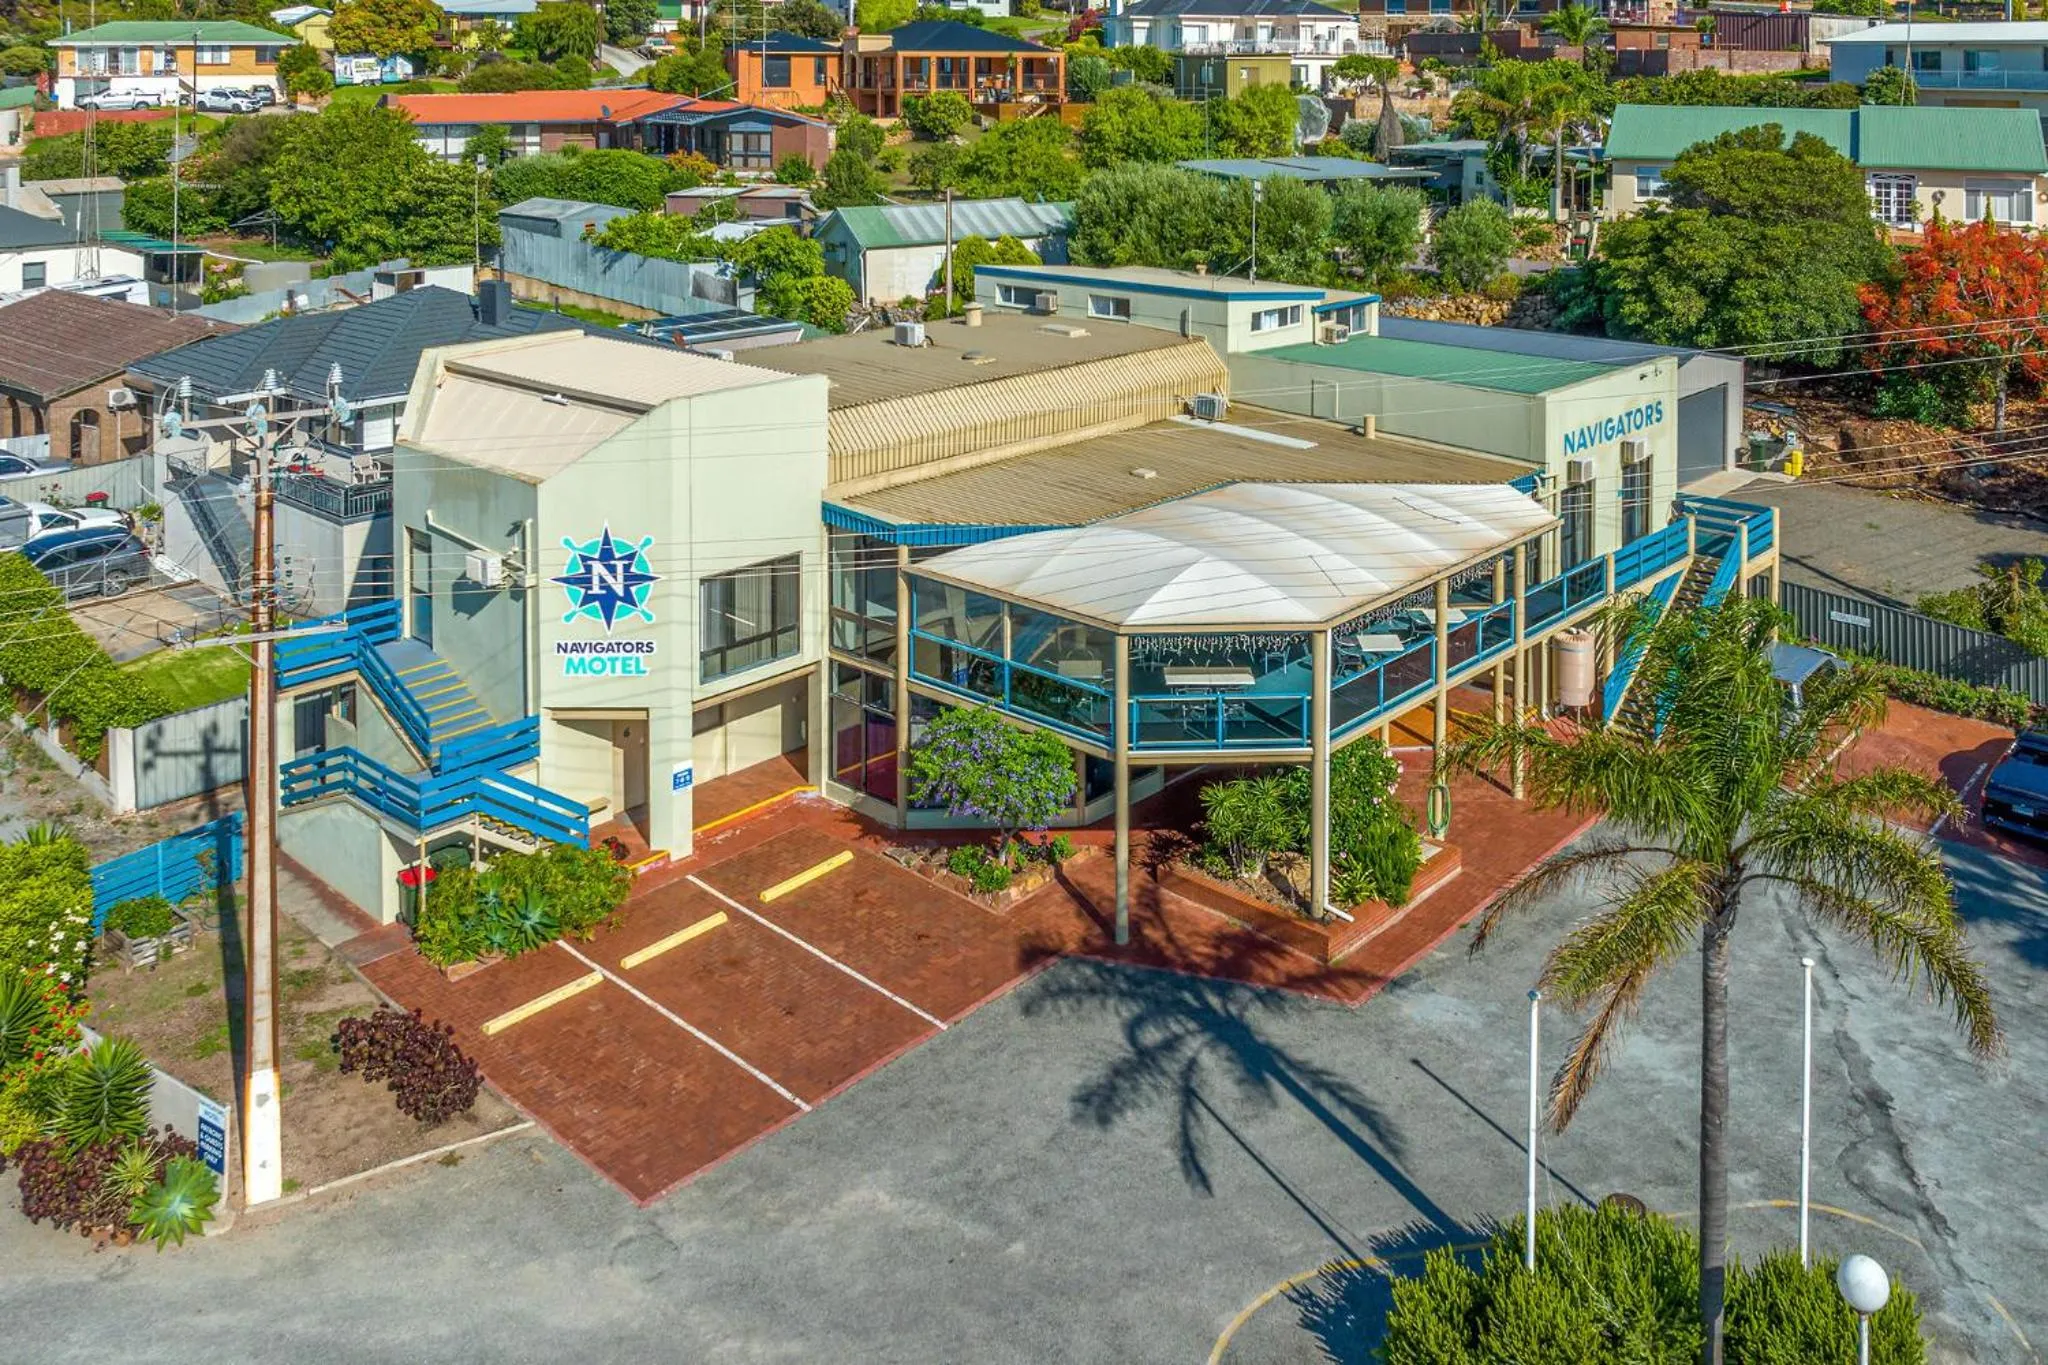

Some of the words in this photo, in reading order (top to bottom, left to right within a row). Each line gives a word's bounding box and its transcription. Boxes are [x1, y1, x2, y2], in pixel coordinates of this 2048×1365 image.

[1563, 400, 1664, 456] NAVIGATORS
[586, 560, 630, 597] N
[556, 641, 655, 654] NAVIGATORS
[564, 656, 648, 675] MOTEL
